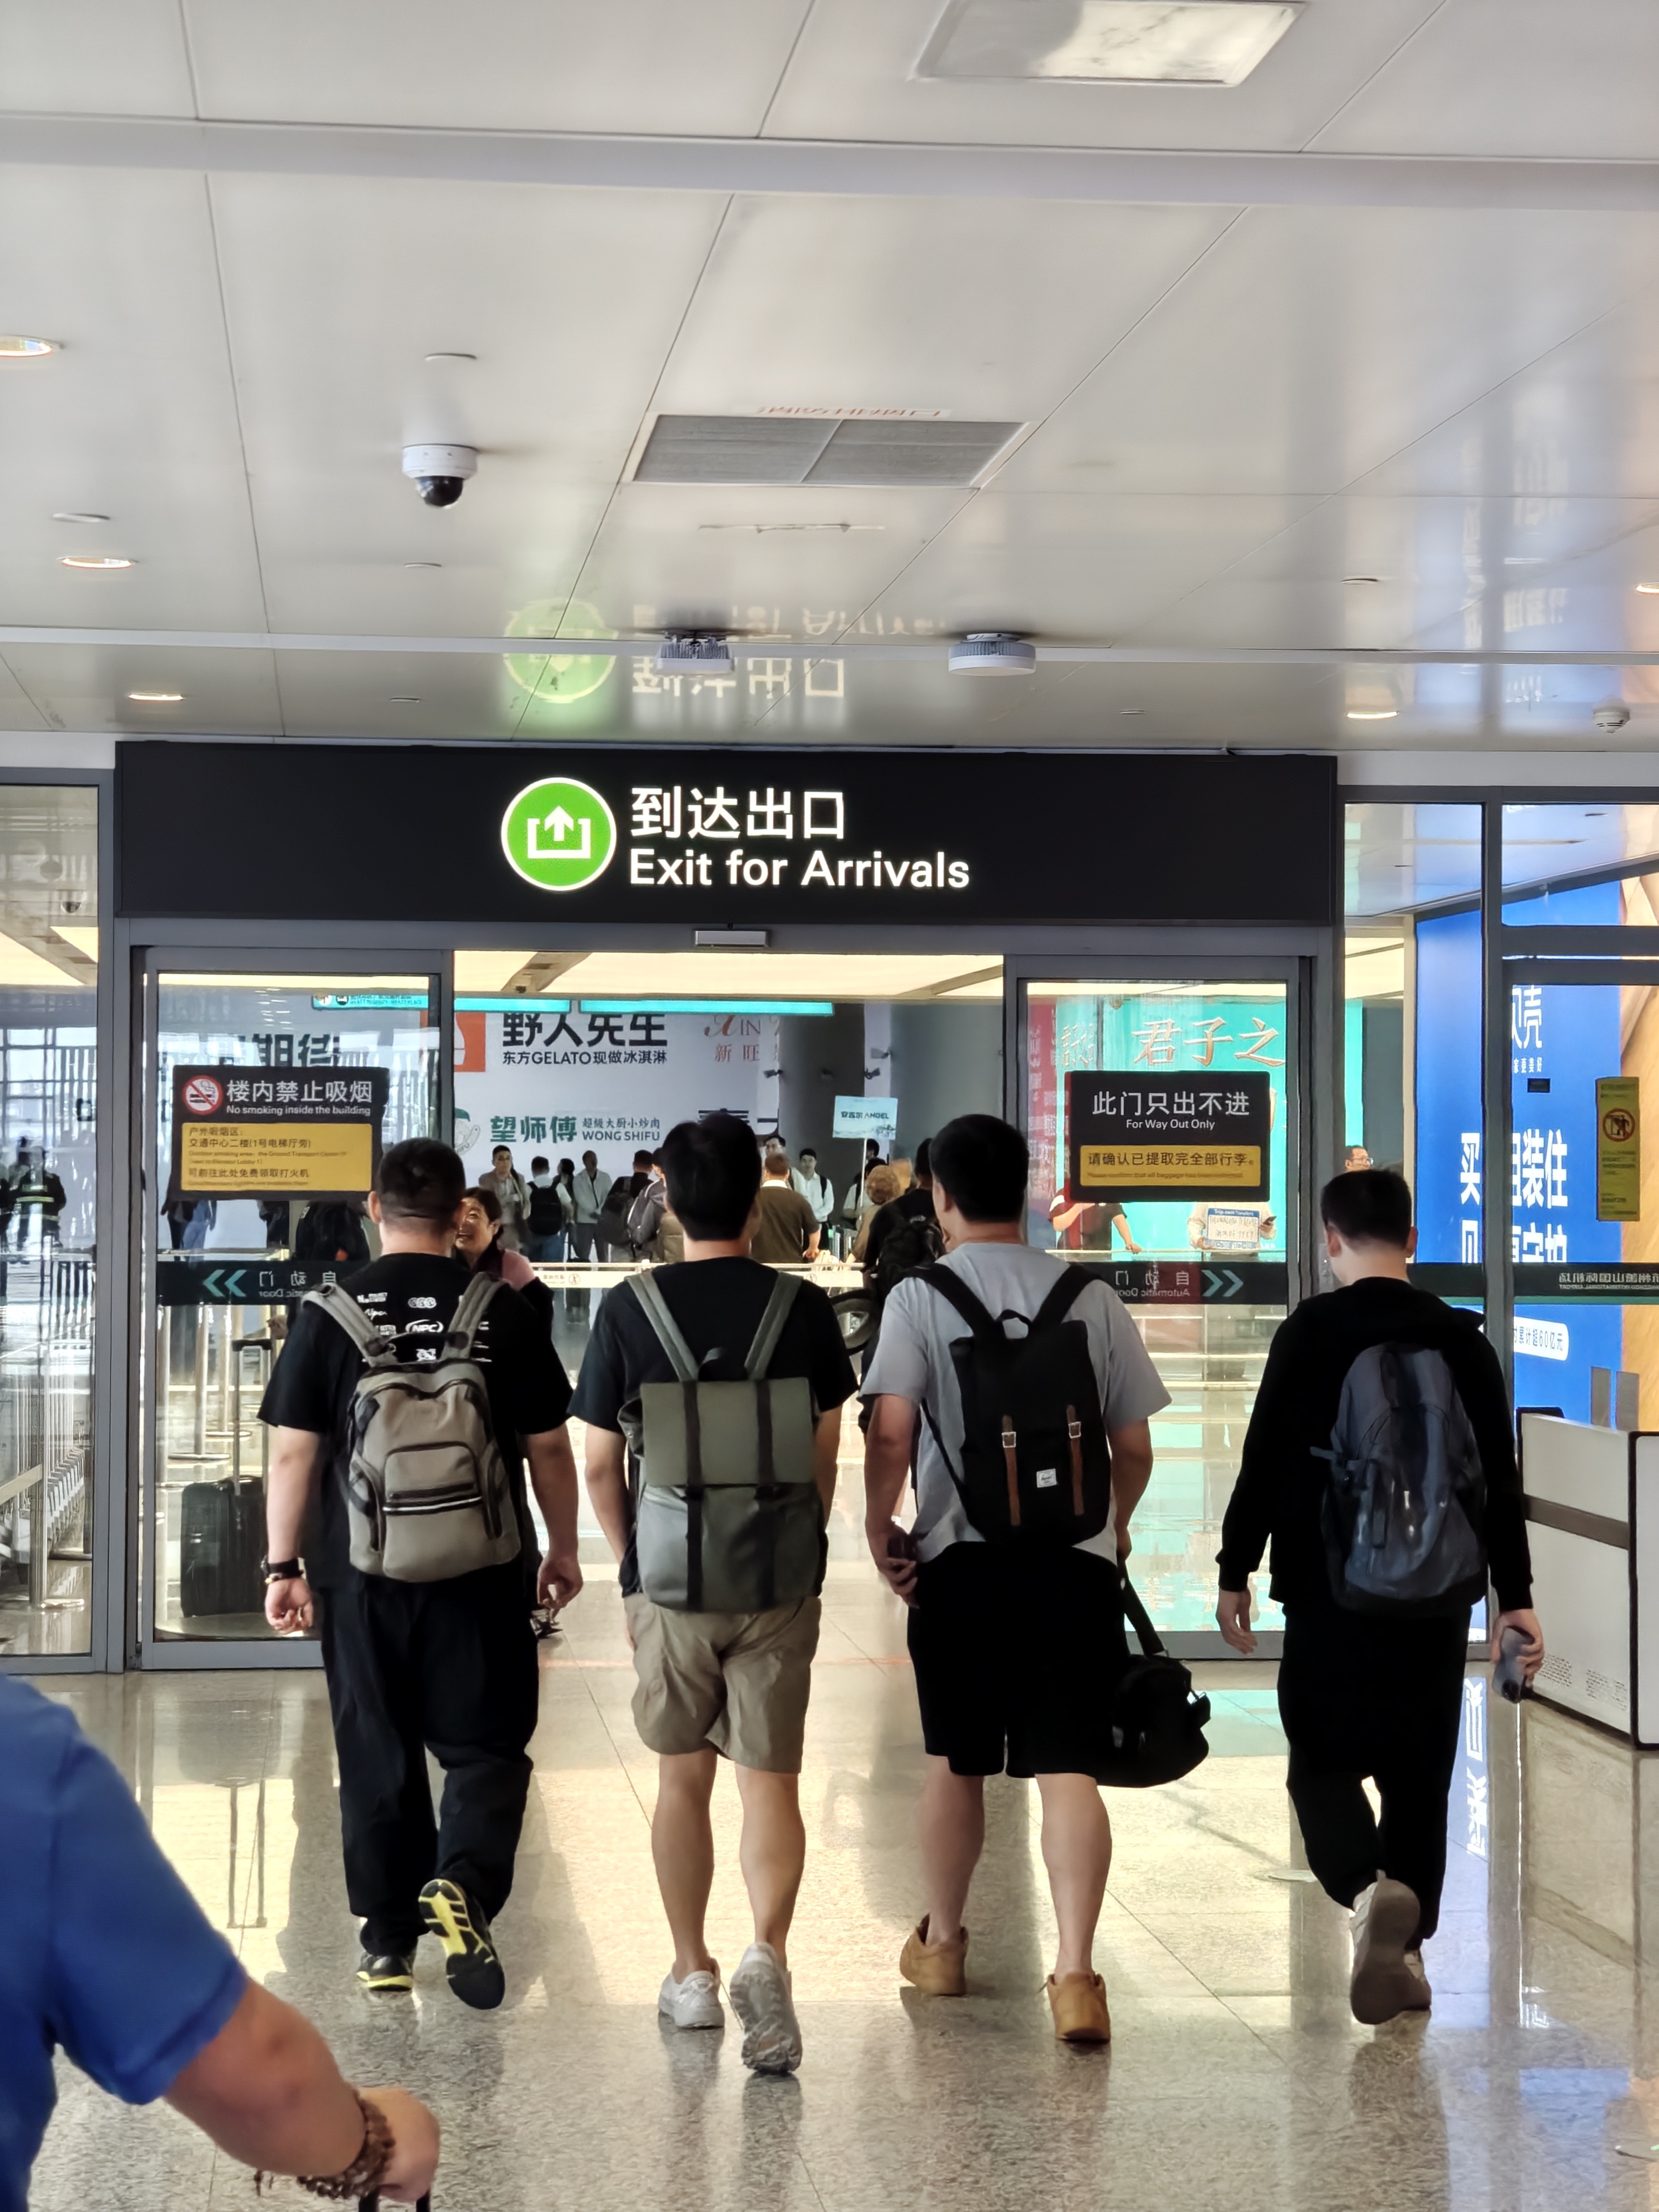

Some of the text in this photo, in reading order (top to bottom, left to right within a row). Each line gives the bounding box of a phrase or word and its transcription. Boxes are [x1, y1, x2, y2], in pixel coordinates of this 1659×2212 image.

[630, 785, 845, 840] 到达出口
[630, 848, 970, 888] Exit for Arrivals
[1132, 1016, 1286, 1067] 君子之
[502, 1050, 667, 1064] 东方GELATO现做冰淇淋
[226, 1080, 372, 1103] 楼内禁止吸烟
[227, 1105, 371, 1116] No smoking inside the building
[1092, 1091, 1250, 1116] 此门只出不进
[490, 1115, 577, 1144] 望师傅
[582, 1131, 660, 1141] WONG SHIFU
[1126, 1119, 1215, 1130] For Way Out Only
[1088, 1152, 1253, 1166] 请确认已提取完全部行李。
